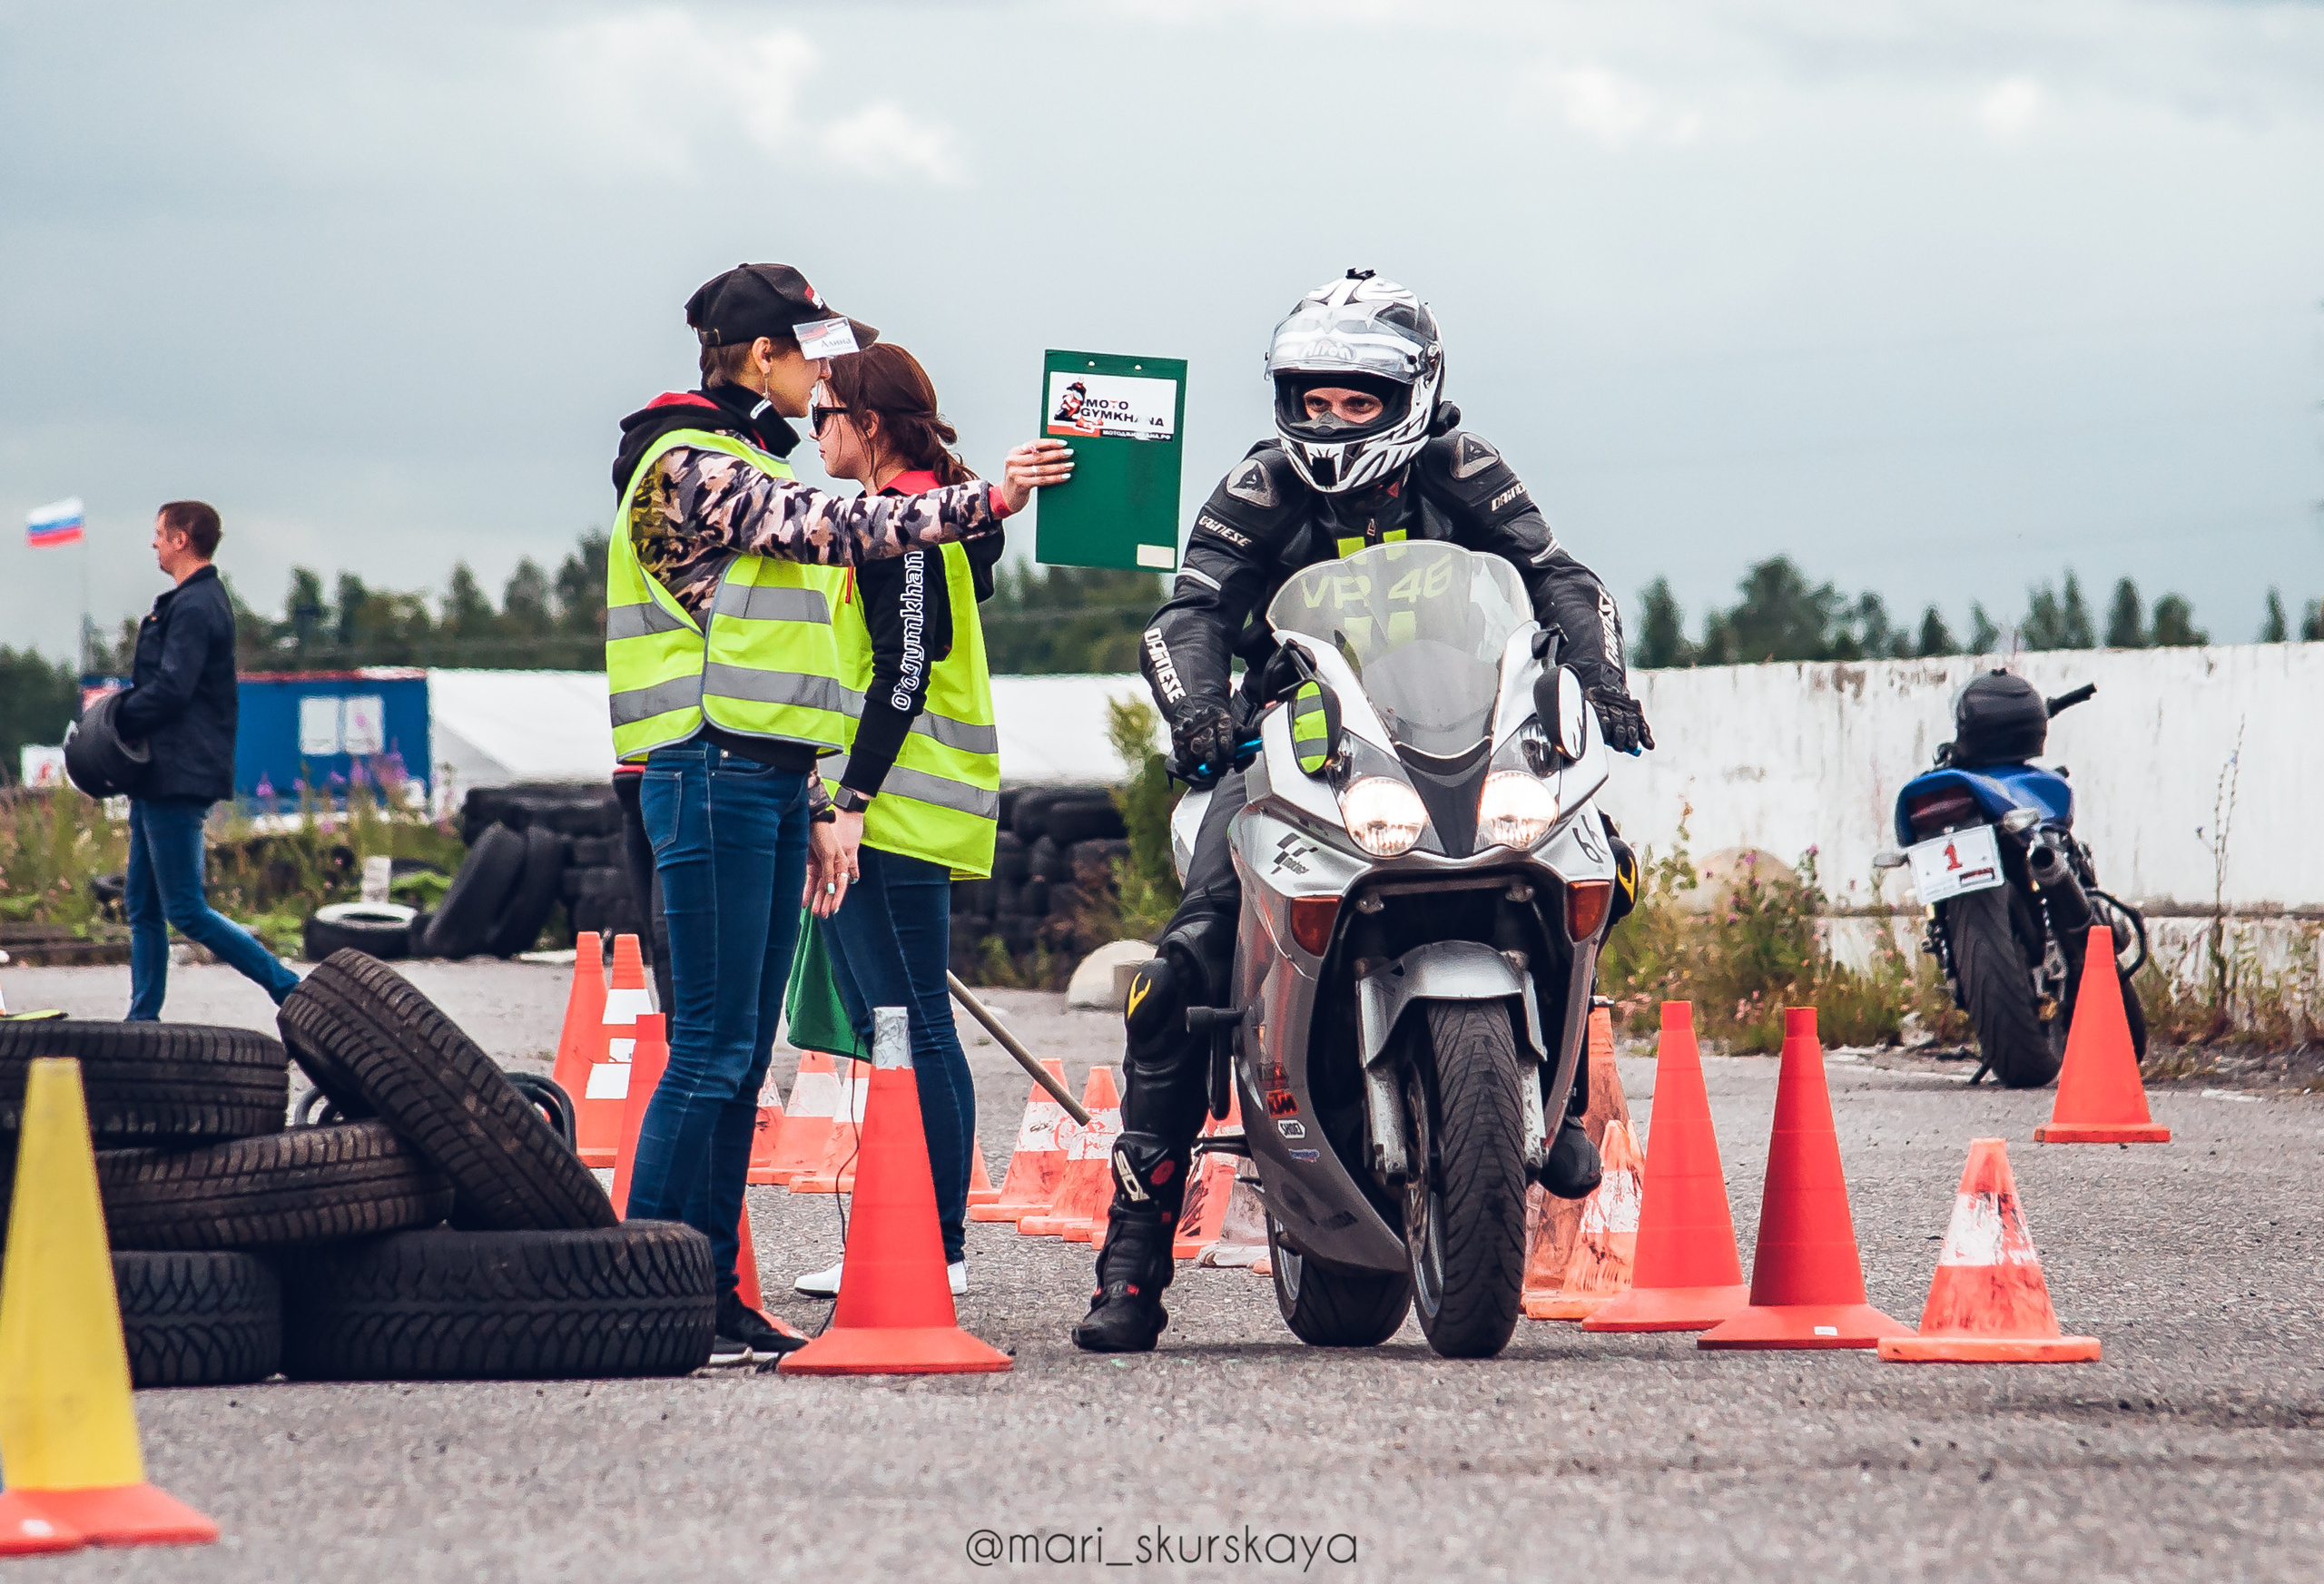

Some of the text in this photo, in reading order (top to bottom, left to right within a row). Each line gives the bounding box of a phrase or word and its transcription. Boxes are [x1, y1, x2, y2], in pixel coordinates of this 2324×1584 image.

[821, 337, 852, 349] Алина
[1085, 398, 1129, 410] MOTO
[1080, 408, 1165, 428] GYMKHNA
[1387, 552, 1452, 604] 46
[1143, 626, 1187, 705] DAINESE
[1943, 842, 1964, 872] 1
